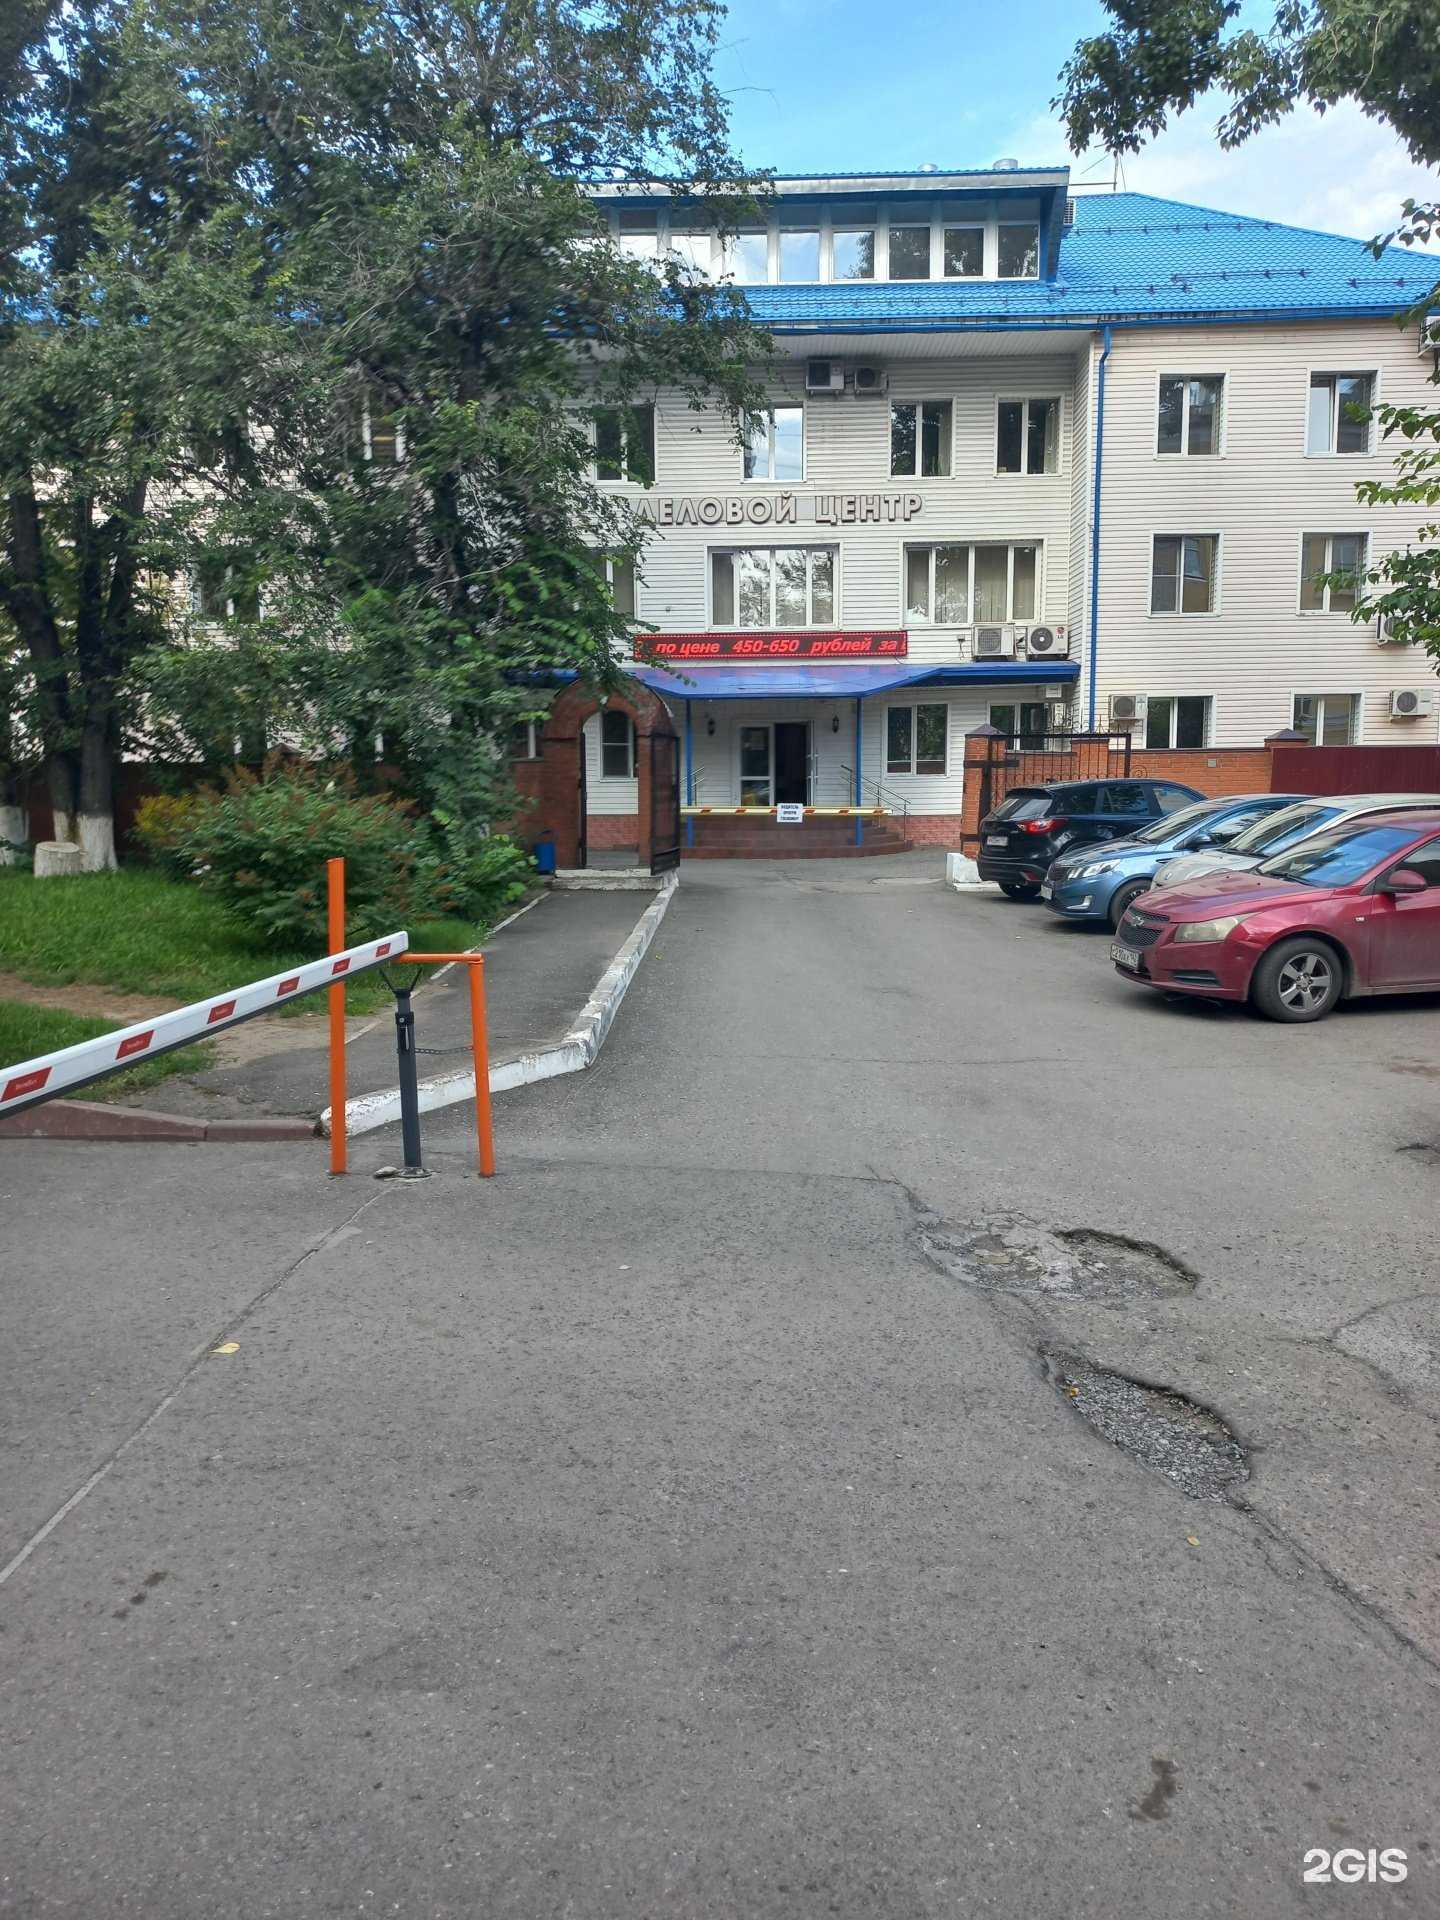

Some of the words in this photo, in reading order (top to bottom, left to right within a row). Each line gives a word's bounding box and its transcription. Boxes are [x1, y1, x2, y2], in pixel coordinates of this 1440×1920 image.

[814, 494, 923, 526] ЦЕНТР
[655, 642, 677, 654] по
[679, 642, 721, 657] цене
[732, 639, 800, 654] 450-650
[811, 636, 872, 655] рублей
[877, 640, 899, 652] за
